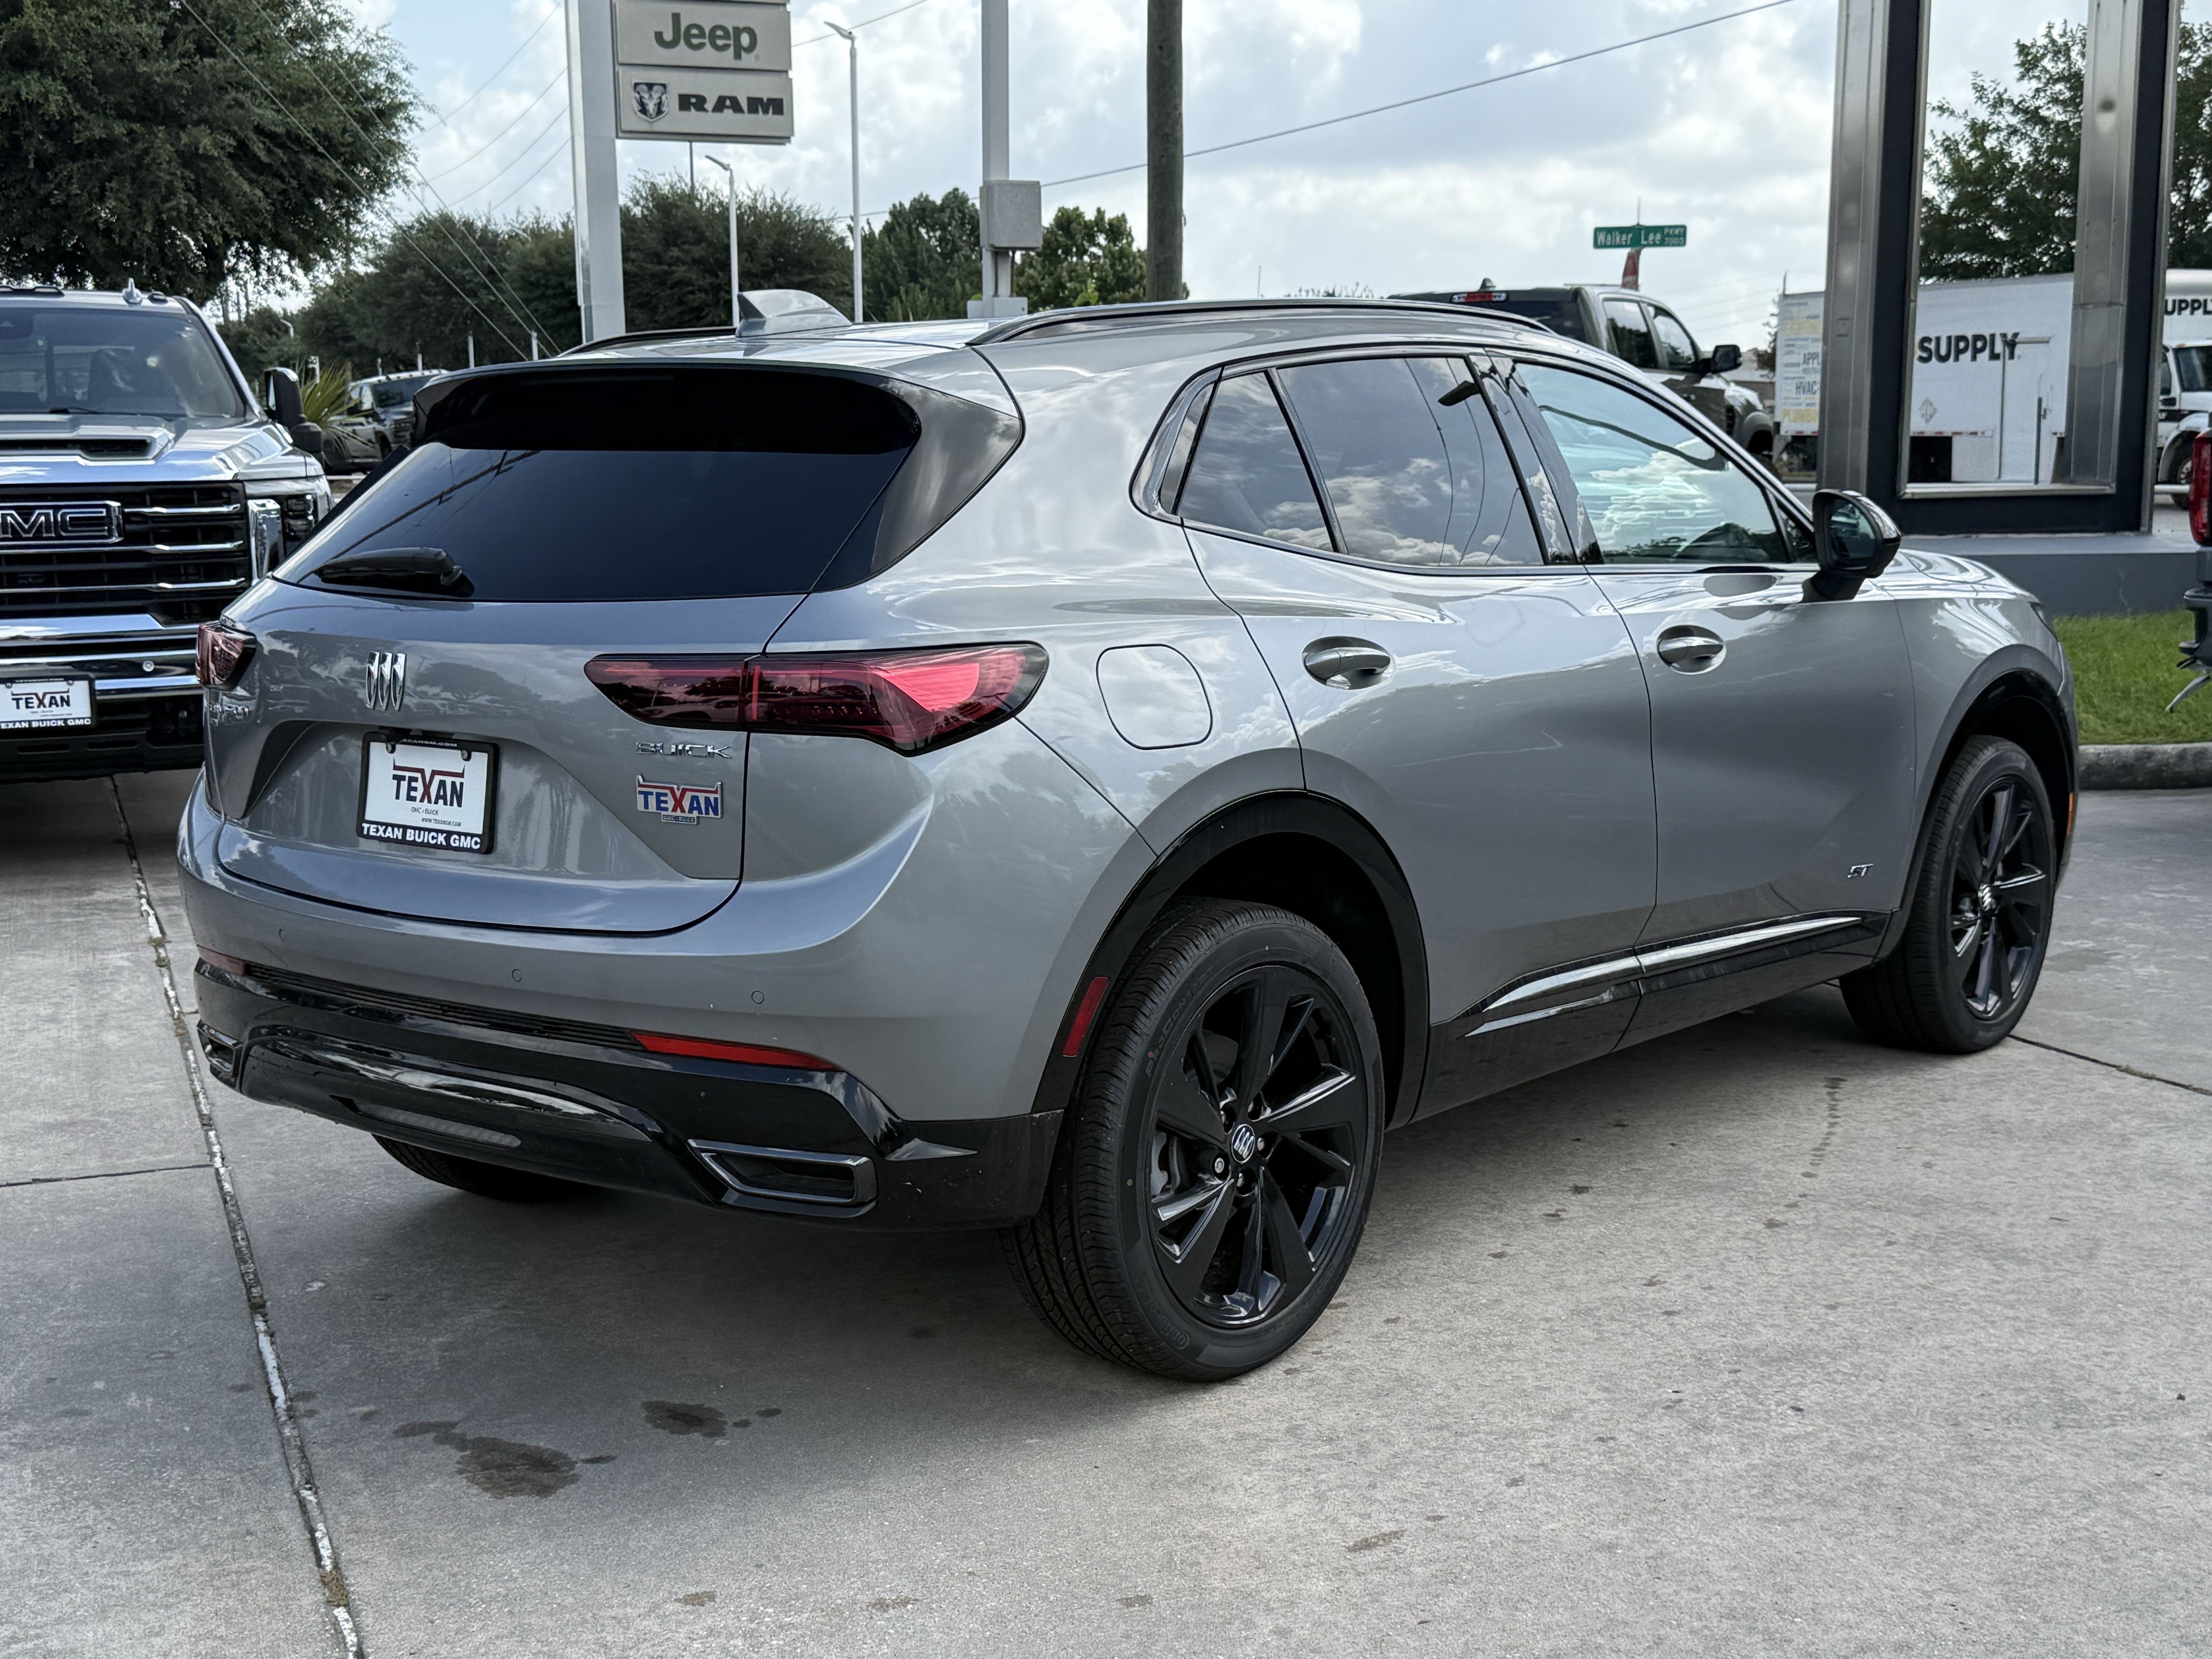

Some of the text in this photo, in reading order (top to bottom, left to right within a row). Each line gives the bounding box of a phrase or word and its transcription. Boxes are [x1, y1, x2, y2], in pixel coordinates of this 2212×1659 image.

[654, 13, 757, 60] Jeep
[678, 94, 784, 115] RAM
[1597, 231, 1633, 246] Walker
[1641, 230, 1661, 244] Lee
[2165, 299, 2212, 316] UPPL
[1917, 332, 2020, 364] SUPPLY
[1802, 352, 1820, 366] APPL
[0, 508, 108, 538] MC
[12, 692, 71, 709] TEXAN
[636, 742, 732, 759] BUICK
[392, 766, 465, 807] TEXAN
[638, 783, 719, 816] TEXAN
[362, 823, 481, 849] TEXAN BUICK GMC
[1847, 864, 1874, 878] ST
